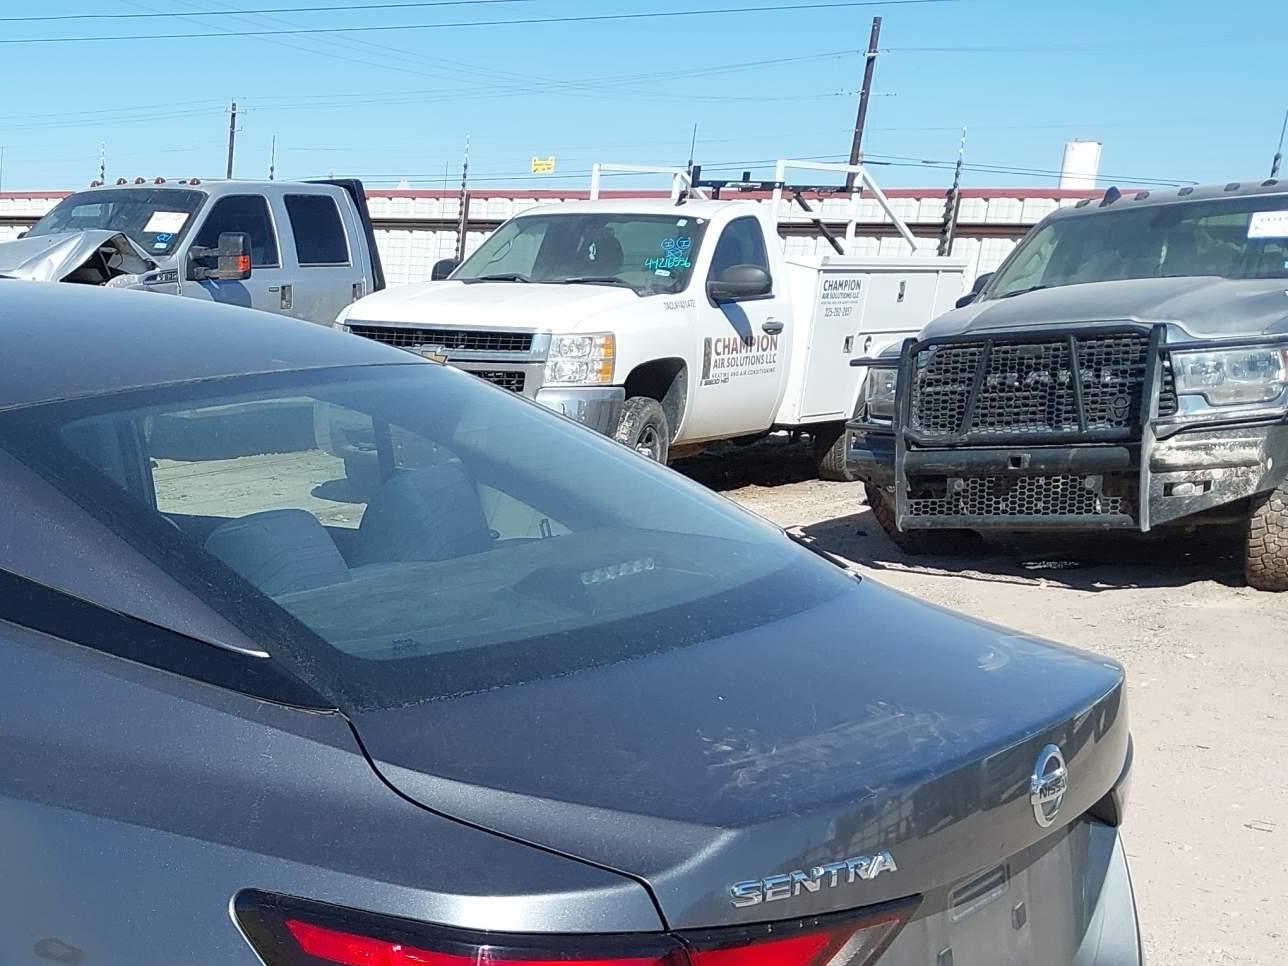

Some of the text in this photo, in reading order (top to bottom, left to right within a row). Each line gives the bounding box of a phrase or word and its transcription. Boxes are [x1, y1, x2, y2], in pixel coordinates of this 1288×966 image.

[823, 280, 862, 291] CHAMPION
[714, 334, 778, 356] CHAMPION
[713, 353, 777, 370] AIR SOLUTIONS LLC
[729, 850, 898, 909] SENTRA
